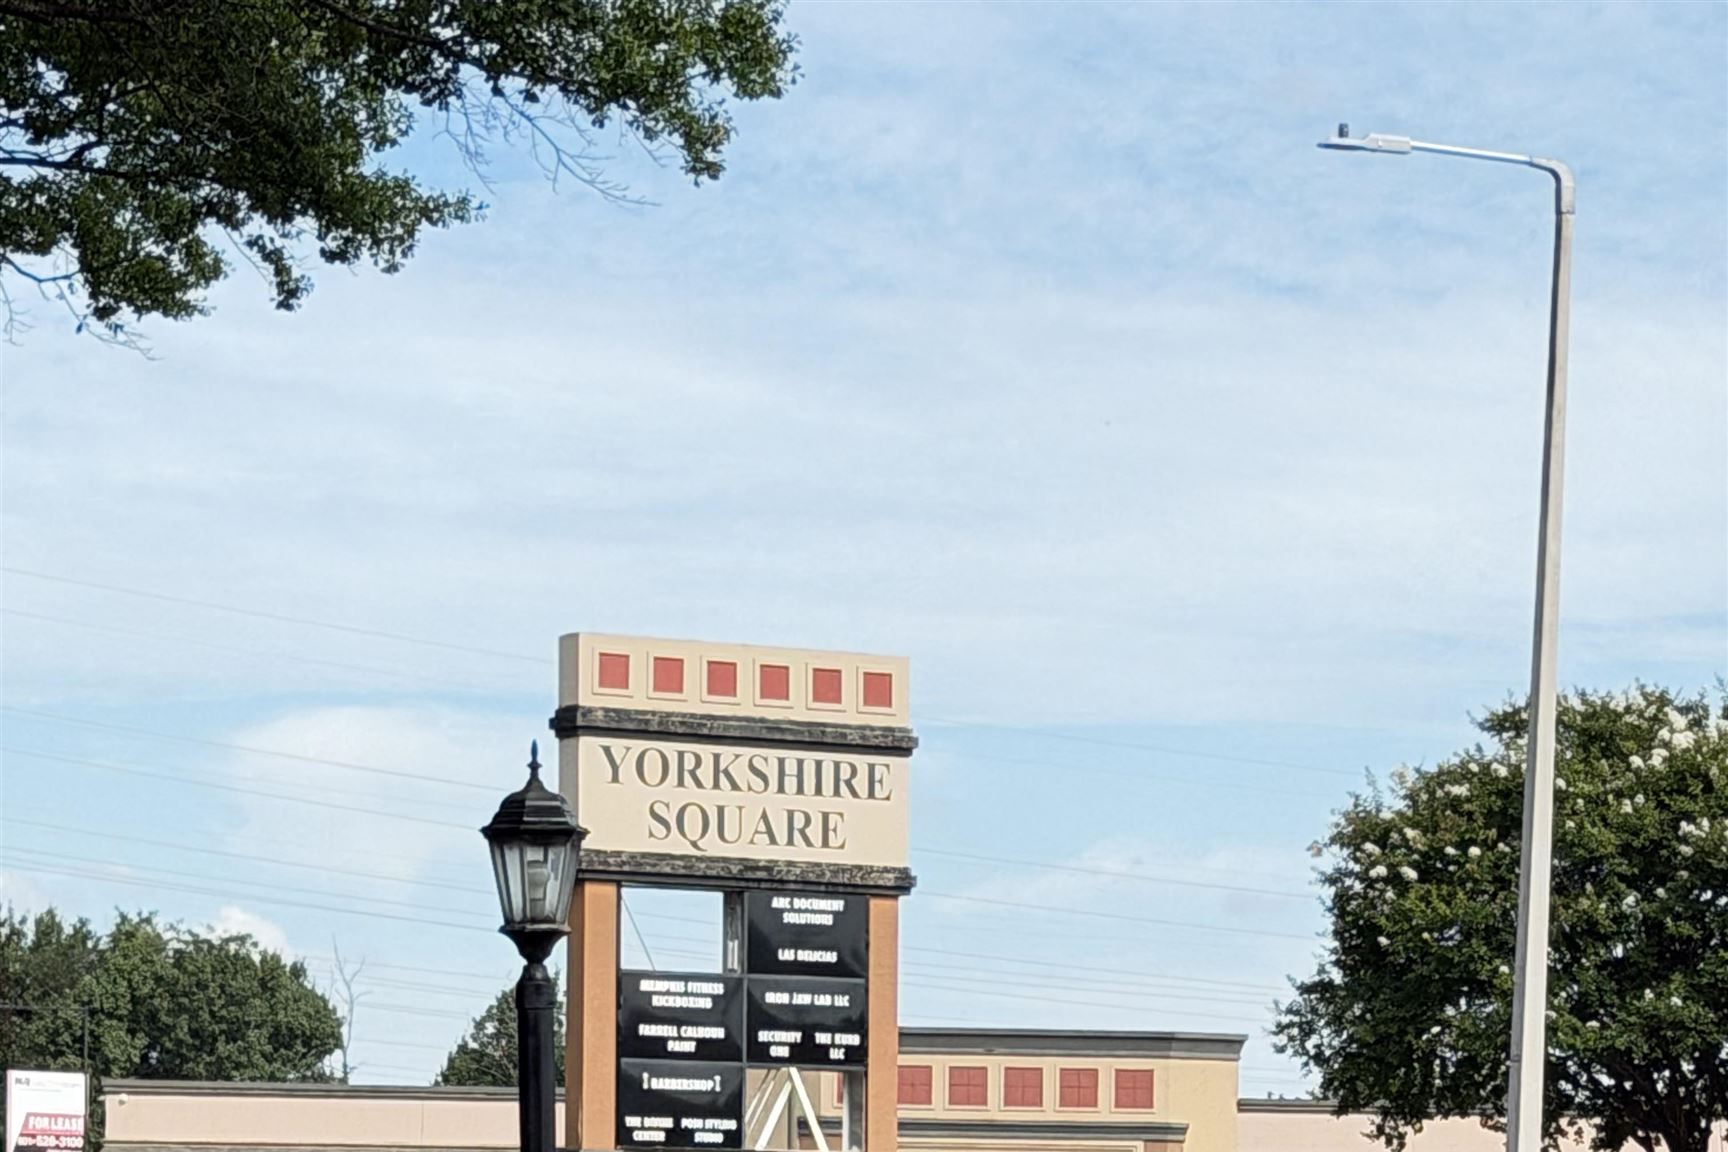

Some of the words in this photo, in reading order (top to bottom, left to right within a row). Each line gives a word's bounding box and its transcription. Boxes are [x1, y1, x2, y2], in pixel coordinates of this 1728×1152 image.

[600, 744, 893, 800] YORKSHIRE
[648, 799, 847, 852] SQUARE
[793, 898, 844, 911] DOCUMENT
[783, 912, 833, 925] SOLUTIONS
[778, 949, 795, 960] LAS
[797, 950, 837, 962] DELICIAS
[640, 980, 685, 992] MEMPHIS
[687, 982, 724, 994] FITNESS
[652, 995, 712, 1008] KICKBOXING
[834, 995, 849, 1006] LLC
[681, 1026, 724, 1038] CALHOUN
[758, 1031, 801, 1042] SECURITY
[668, 1040, 696, 1051] PAINT
